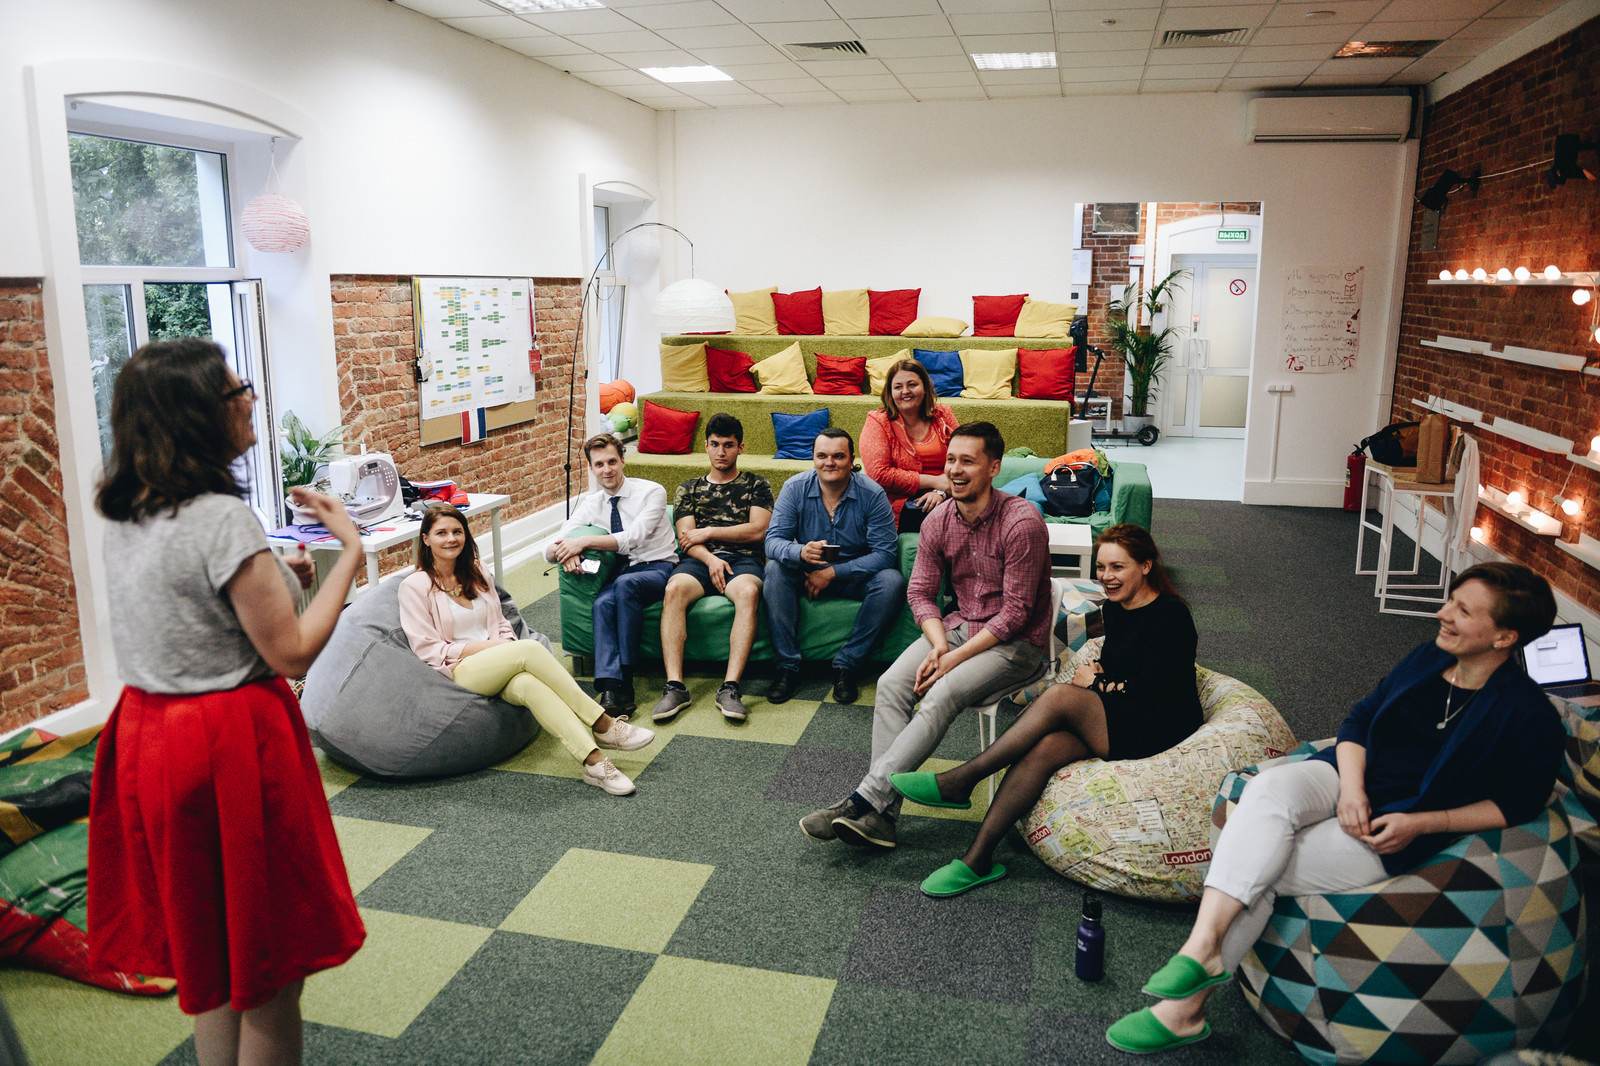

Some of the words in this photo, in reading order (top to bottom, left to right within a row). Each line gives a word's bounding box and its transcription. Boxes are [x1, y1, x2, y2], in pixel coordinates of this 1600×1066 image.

[1219, 231, 1245, 239] ВЫХОД
[1298, 354, 1346, 367] RELAX
[1163, 851, 1212, 864] London
